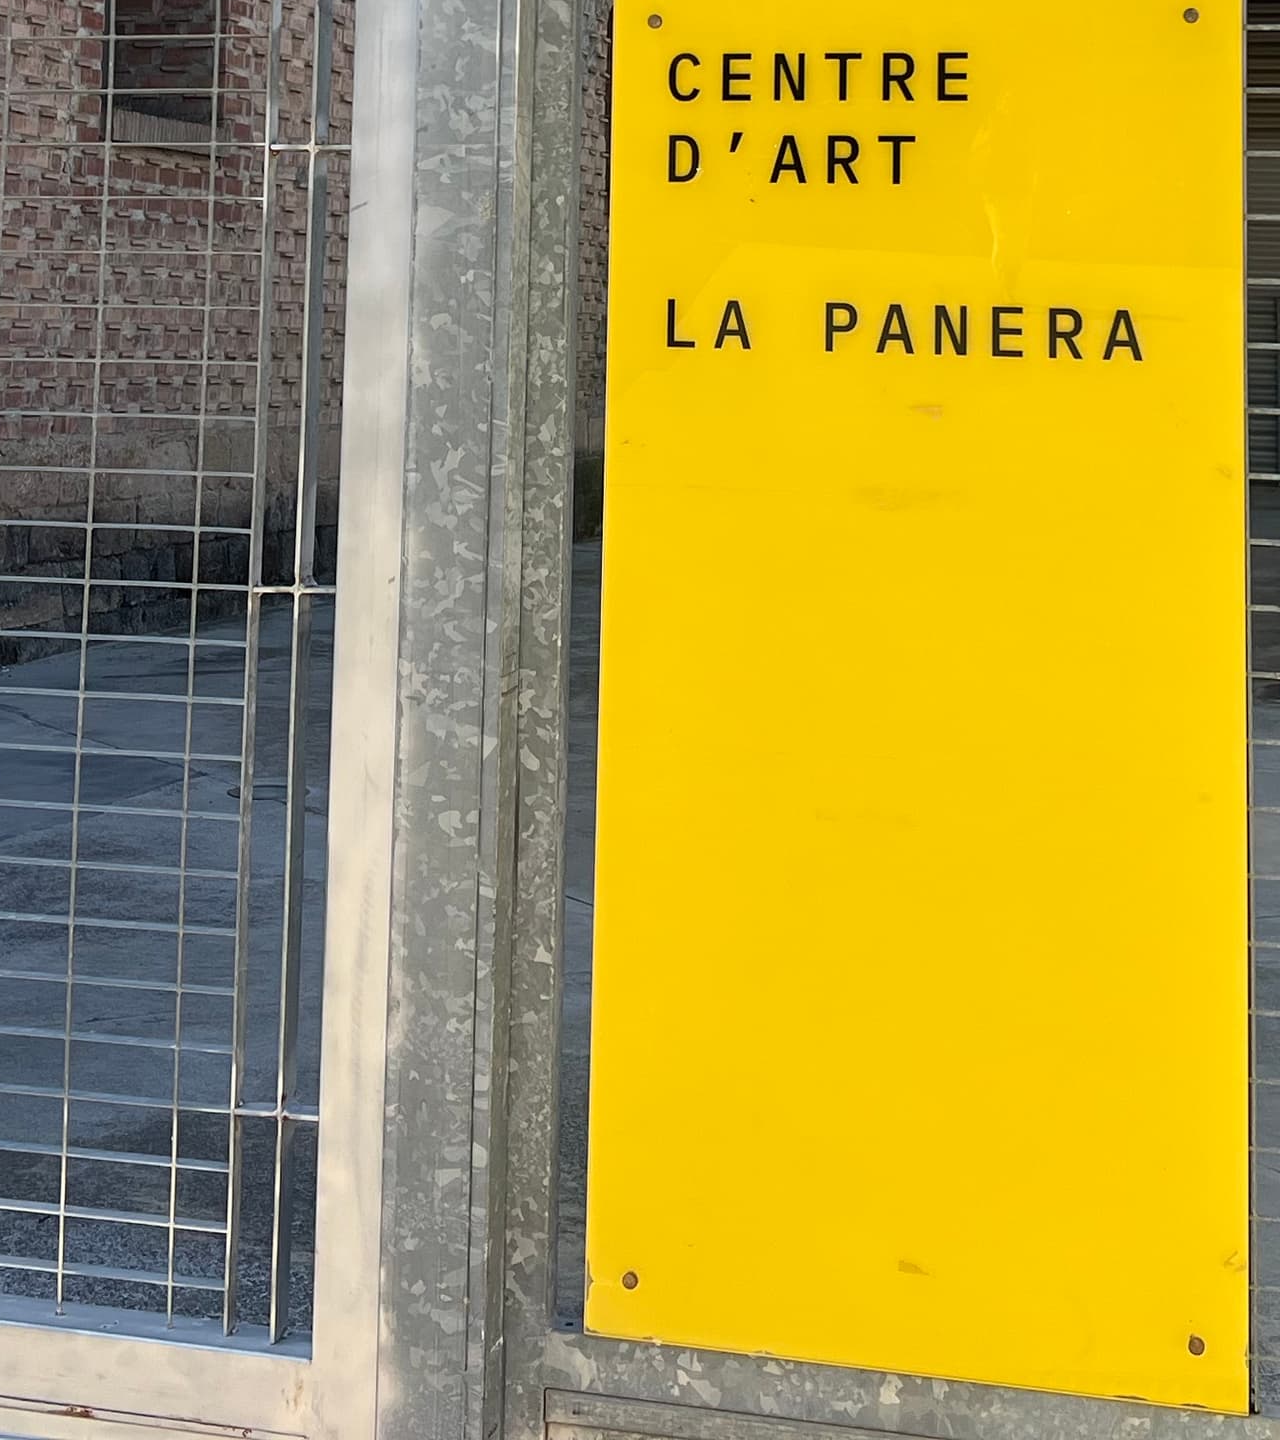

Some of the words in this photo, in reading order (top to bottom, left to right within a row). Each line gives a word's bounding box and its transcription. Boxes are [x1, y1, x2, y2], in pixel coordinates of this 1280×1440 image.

[667, 51, 970, 102] CENTRE
[667, 131, 916, 185] D'ART
[665, 297, 753, 351] LA
[823, 300, 1144, 362] PANERA
